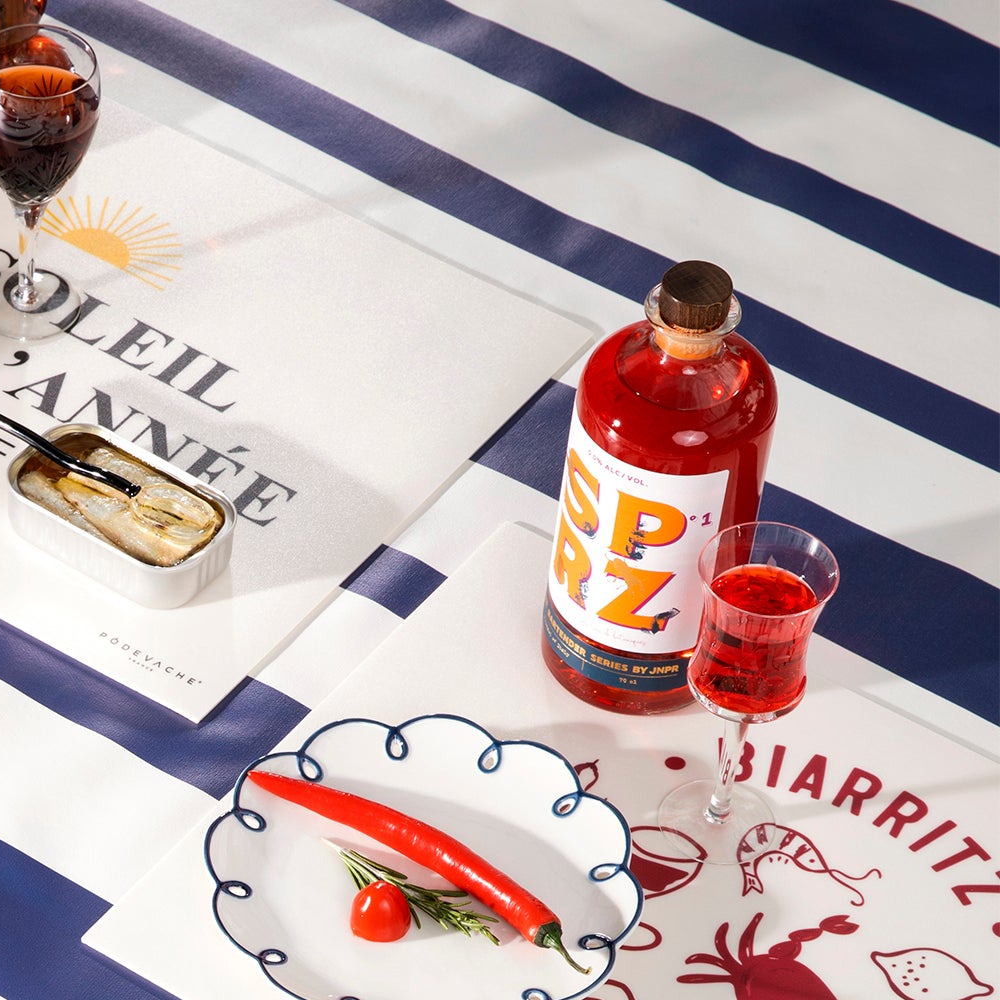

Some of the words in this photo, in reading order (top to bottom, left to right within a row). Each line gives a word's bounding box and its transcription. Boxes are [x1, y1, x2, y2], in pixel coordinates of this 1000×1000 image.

[590, 653, 628, 672] SERIES
[632, 665, 647, 674] BY
[649, 665, 679, 675] JNPR
